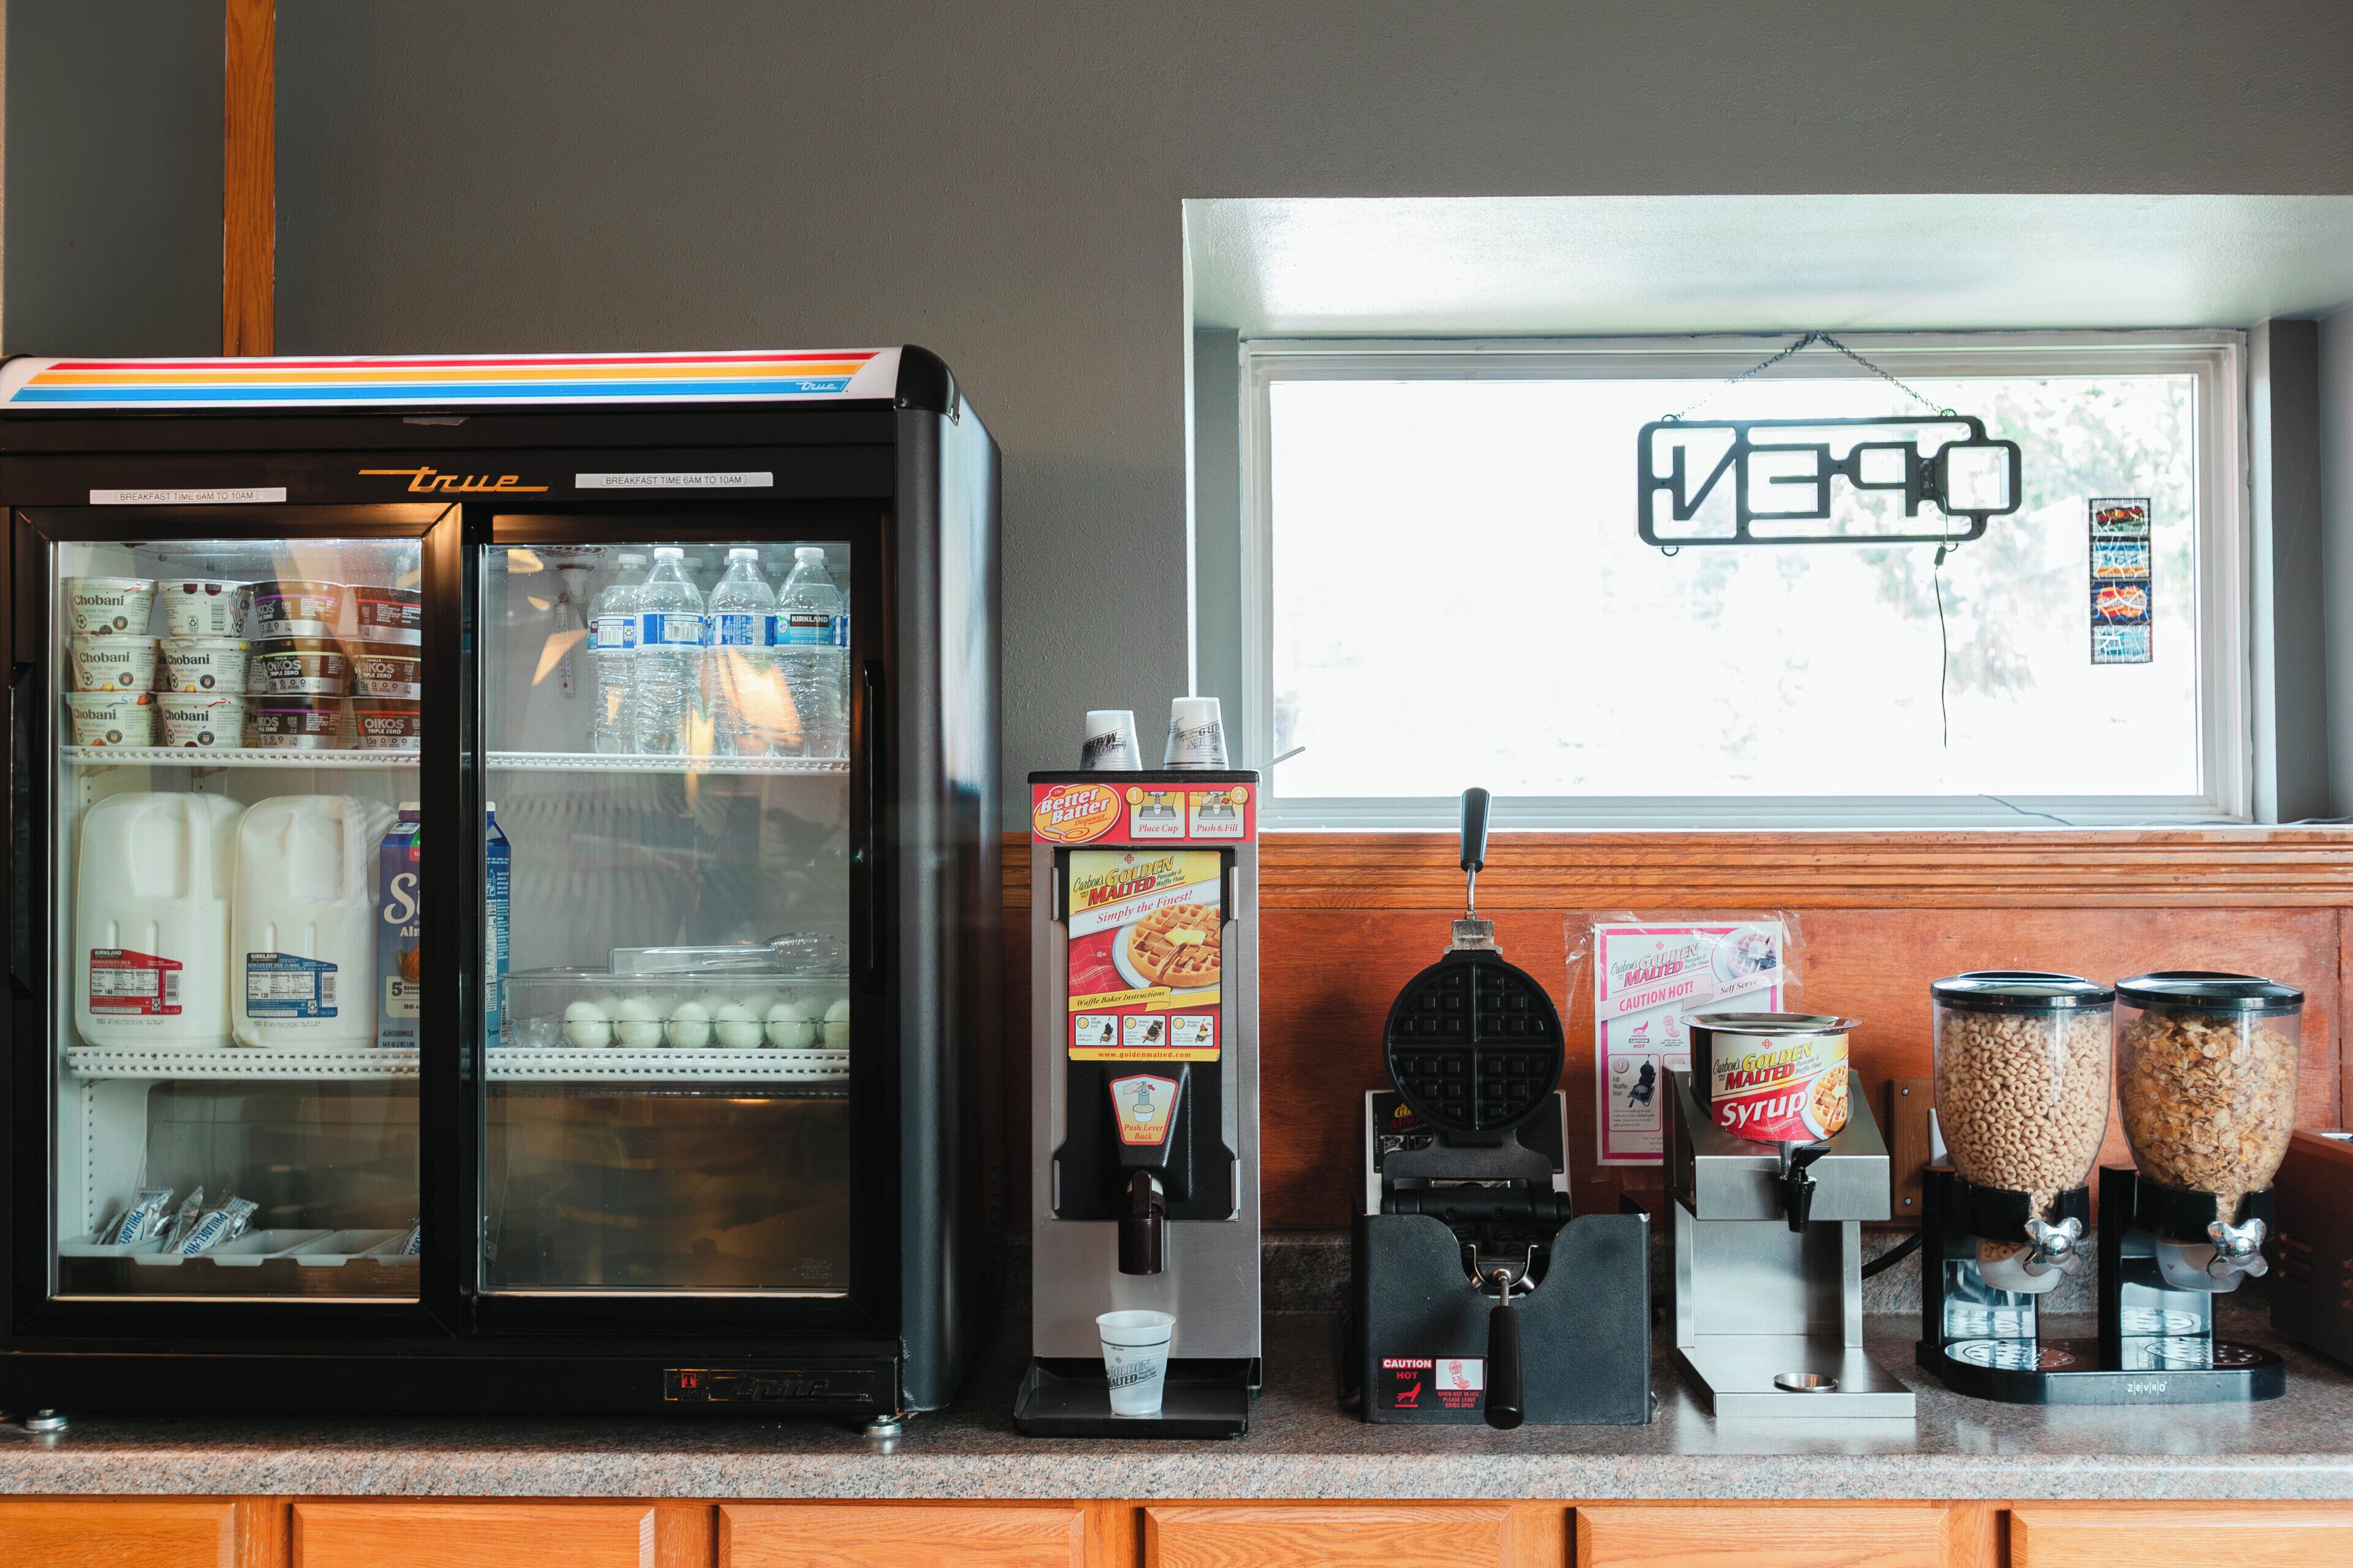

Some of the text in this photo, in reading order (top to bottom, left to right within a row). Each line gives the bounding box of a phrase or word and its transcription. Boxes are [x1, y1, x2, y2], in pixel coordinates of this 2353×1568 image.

[795, 381, 837, 390] true
[358, 466, 549, 492] true
[606, 476, 657, 485] BREAKFAST
[719, 475, 741, 484] 10AM
[120, 492, 171, 501] BREAKFAST
[196, 491, 214, 500] 6AM
[216, 491, 229, 500] TO
[232, 491, 253, 500] 10AM
[74, 594, 124, 606] Chobani
[80, 651, 130, 662] Chobani
[167, 654, 210, 665] Chobani
[267, 660, 301, 672] OIKOS
[361, 662, 395, 674] OIKOS
[74, 708, 116, 720] Chobani
[164, 709, 209, 721] Chobani
[365, 718, 404, 729] OIKOS
[1132, 790, 1137, 801] 1
[1236, 790, 1243, 800] 2
[1039, 787, 1100, 816] Better
[1050, 797, 1110, 825] Batter
[1074, 814, 1106, 826] Dispenser
[1161, 824, 1178, 834] Cup
[1074, 856, 1175, 893] Carbon's GOLDEN
[1157, 871, 1177, 881] Pancake
[1156, 877, 1172, 887] Waffle
[1088, 876, 1156, 906] MALTED
[1097, 889, 1194, 924] Simply the Finest!
[1611, 943, 1699, 976] Carbon's GOLDEN
[1624, 960, 1683, 987] MALTED
[392, 982, 403, 996] 5
[1720, 979, 1758, 994] Self Serve
[1077, 998, 1100, 1007] Waffle
[1123, 990, 1165, 1001] Instructions
[1620, 980, 1693, 1012] CAUTION HOT!
[1713, 1041, 1813, 1075] Carbon's GOLDEN
[1725, 1062, 1795, 1091] MALTED
[1720, 1090, 1808, 1128] Syrup
[1383, 1359, 1431, 1368] CAUTION
